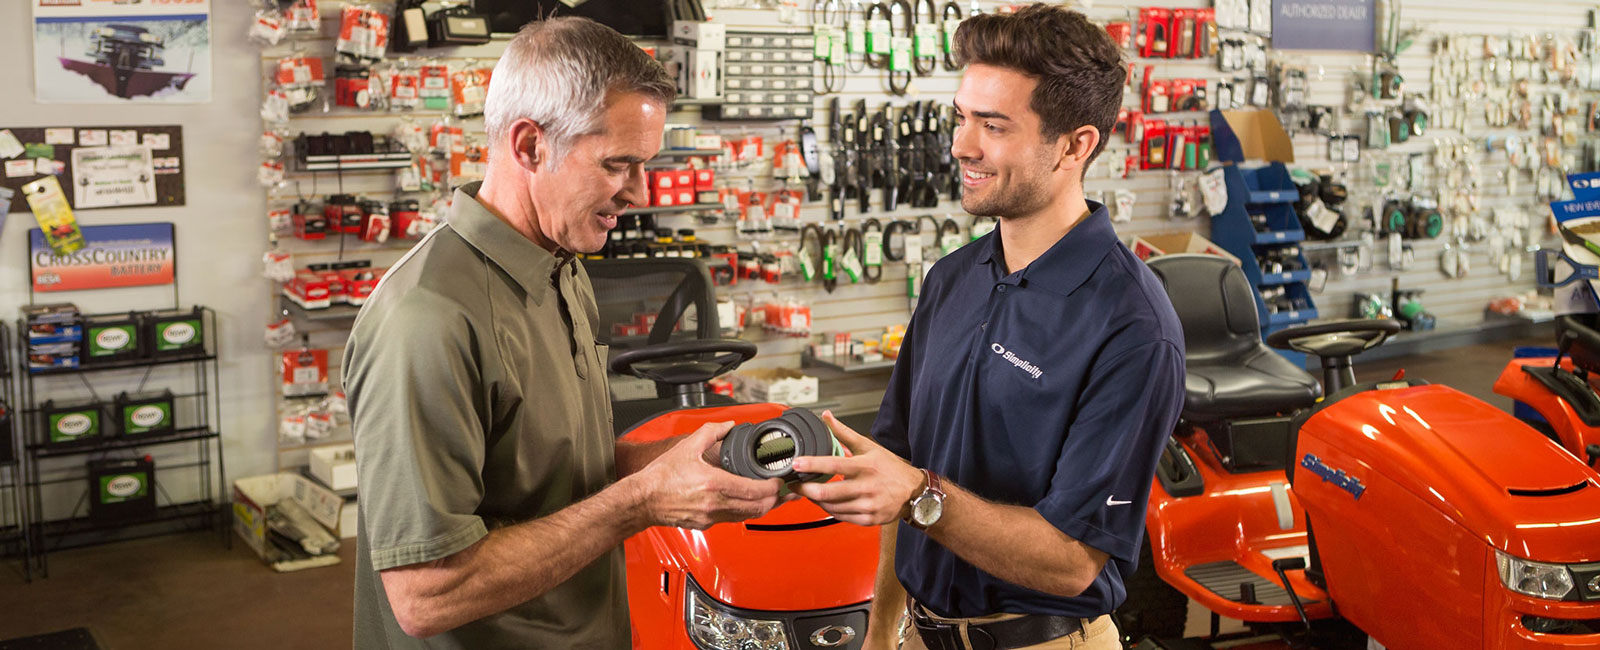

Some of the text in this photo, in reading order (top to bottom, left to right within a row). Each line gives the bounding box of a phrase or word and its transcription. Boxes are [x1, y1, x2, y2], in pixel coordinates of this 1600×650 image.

[1281, 4, 1368, 20] AUTHORIZED DEALER
[1564, 203, 1585, 213] NEW
[111, 265, 163, 276] BATTERY
[1002, 351, 1043, 379] Simplicity
[1301, 453, 1366, 500] Simplicity
